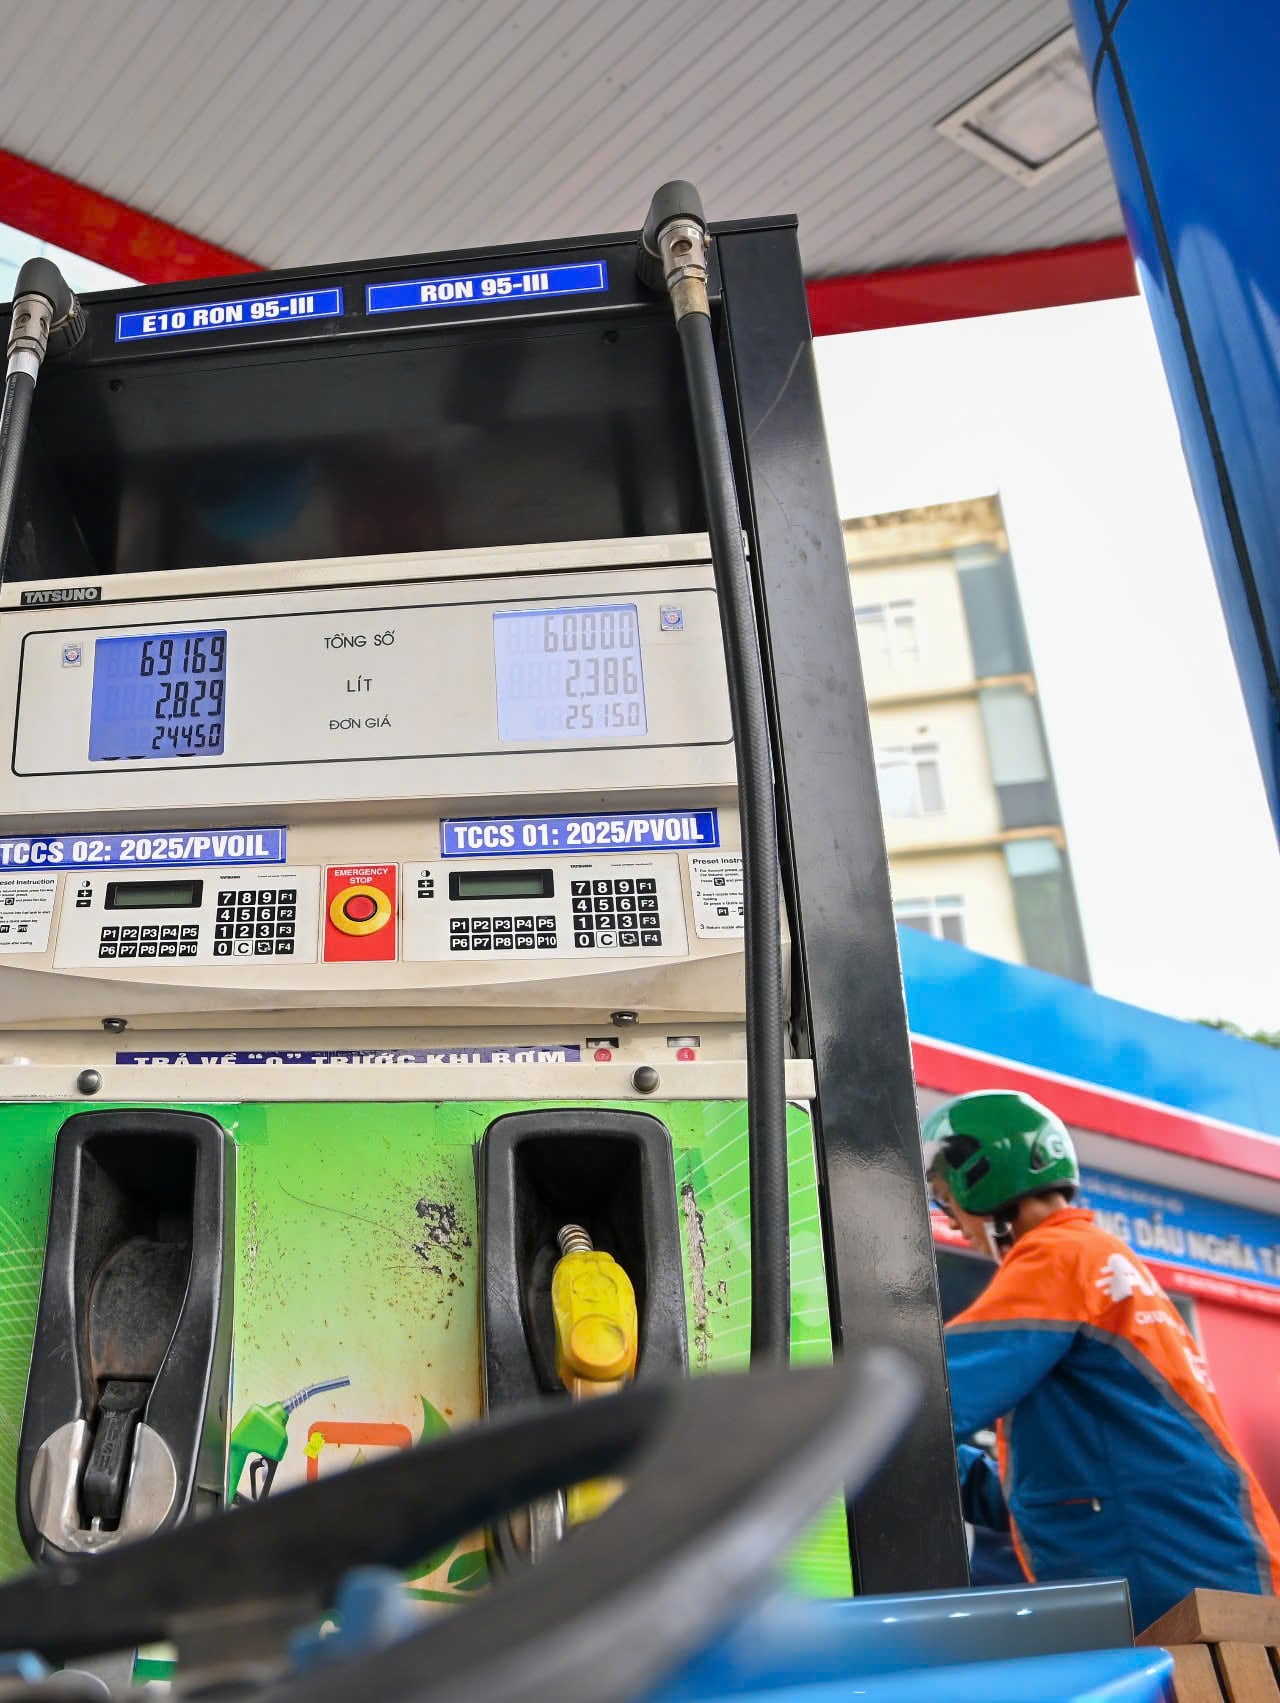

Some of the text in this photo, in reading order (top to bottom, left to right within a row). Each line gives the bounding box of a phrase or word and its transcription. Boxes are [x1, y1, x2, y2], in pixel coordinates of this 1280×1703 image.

[420, 273, 549, 303] RON 95-III
[142, 296, 314, 333] E10 RON 95-III
[25, 588, 98, 604] TATSUNO
[543, 611, 634, 653] 60000
[324, 630, 395, 649] TỔNG SỐ
[141, 637, 225, 676] 69169
[347, 675, 373, 692] LÍT
[565, 656, 638, 699] 2,386
[156, 680, 224, 721] 2,829
[329, 714, 392, 730] ĐƠN GIÁ
[566, 702, 640, 730] 25150
[152, 723, 221, 750] 24450
[453, 816, 705, 849] TCCS 01: 2025/PVOIL
[0, 834, 269, 865] TCCS 02: 2025/PVOIL
[334, 868, 388, 876] EMERGENCY
[16, 878, 55, 886] Instruction
[575, 882, 586, 894] 7
[597, 882, 607, 893] 8
[619, 881, 629, 893] 9
[222, 892, 293, 904] 7 8 9 F1
[577, 899, 655, 911] 4 5 6 F2
[220, 909, 293, 920] 4 5 6 F2
[452, 919, 554, 930] P1 P2 P3 P4 P5
[578, 916, 657, 928] 1 2 3 F3
[103, 927, 197, 938] P1 P2 P3 P4 P5
[220, 925, 291, 937] 1 2 3 F3
[452, 936, 556, 947] P6 P7 P8 P9 P10
[579, 934, 658, 946] 0 C F4
[100, 944, 197, 955] P6 P7 P8 P9 P10
[218, 942, 291, 954] 0 C F4
